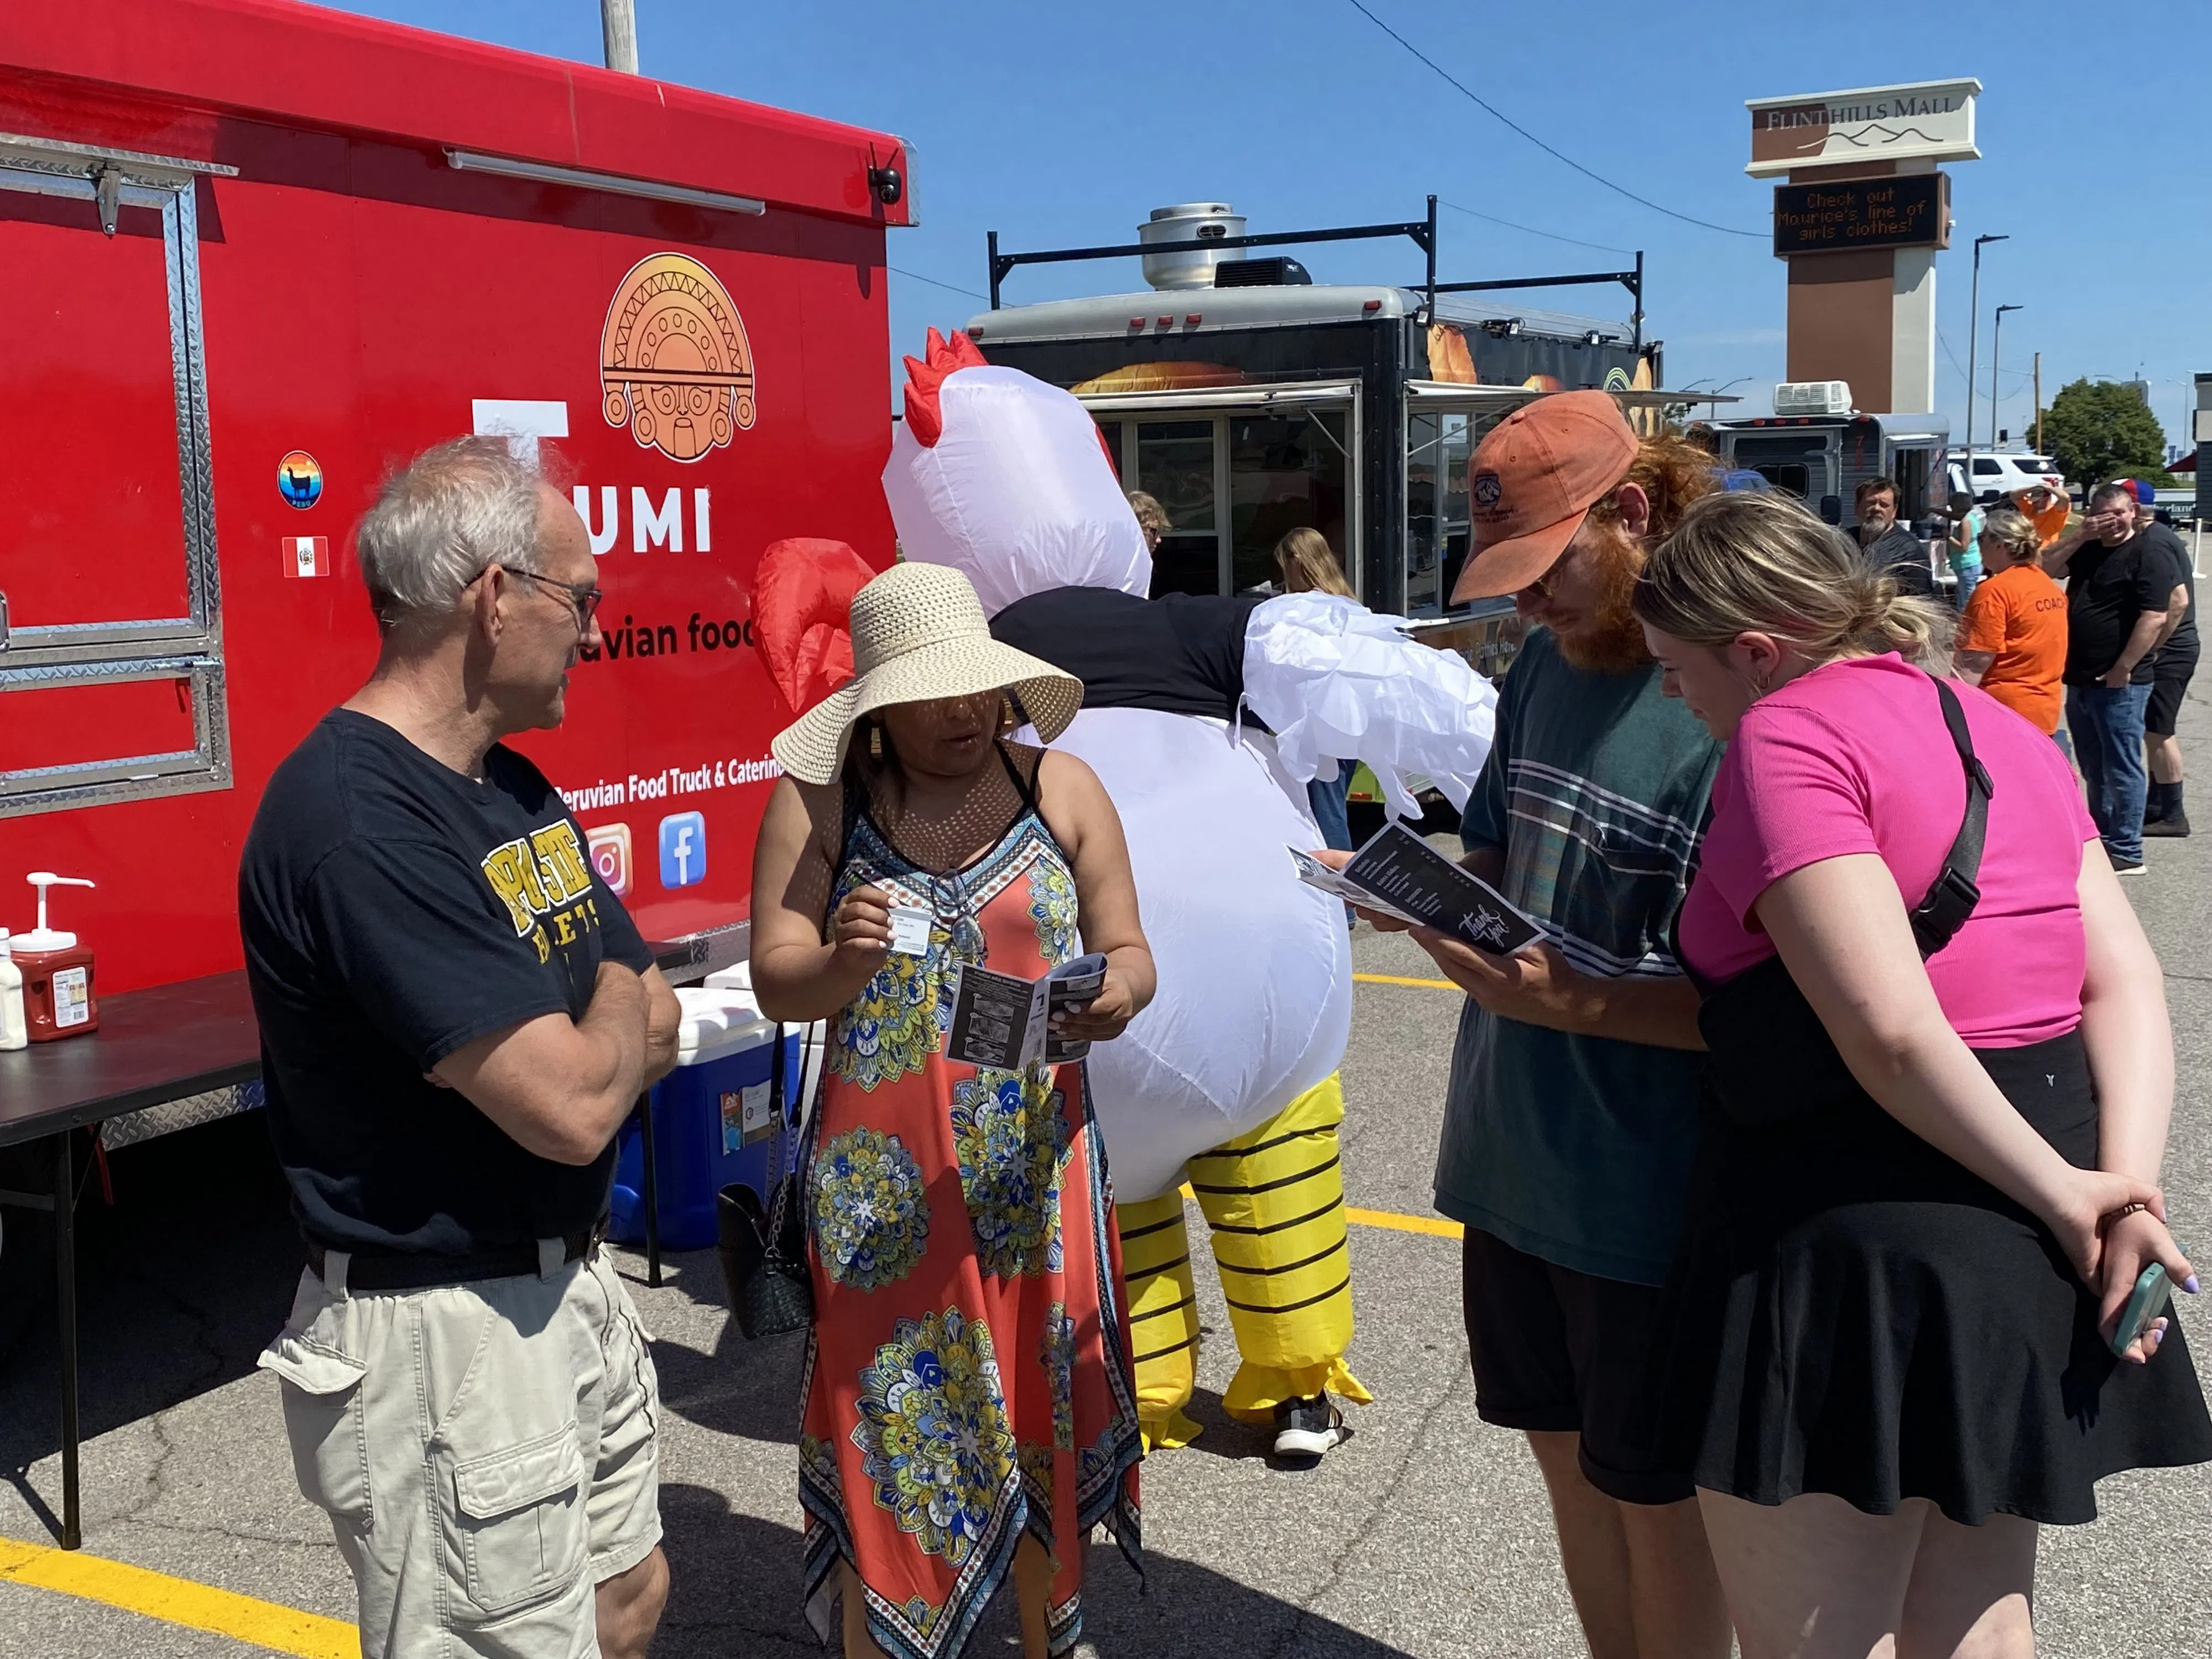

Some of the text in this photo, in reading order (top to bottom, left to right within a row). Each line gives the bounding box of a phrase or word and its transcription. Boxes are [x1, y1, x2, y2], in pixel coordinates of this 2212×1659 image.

[1894, 97, 1955, 117] MALL
[1807, 187, 1894, 208] Check out
[1777, 200, 1927, 226] Maurice's line of
[1799, 216, 1913, 241] girls clothes!
[292, 499, 311, 508] PERU
[1475, 640, 1498, 659] Patties
[628, 770, 667, 803] Food
[670, 764, 711, 795] Truck
[714, 761, 726, 787] &
[1459, 904, 1500, 937] Thank
